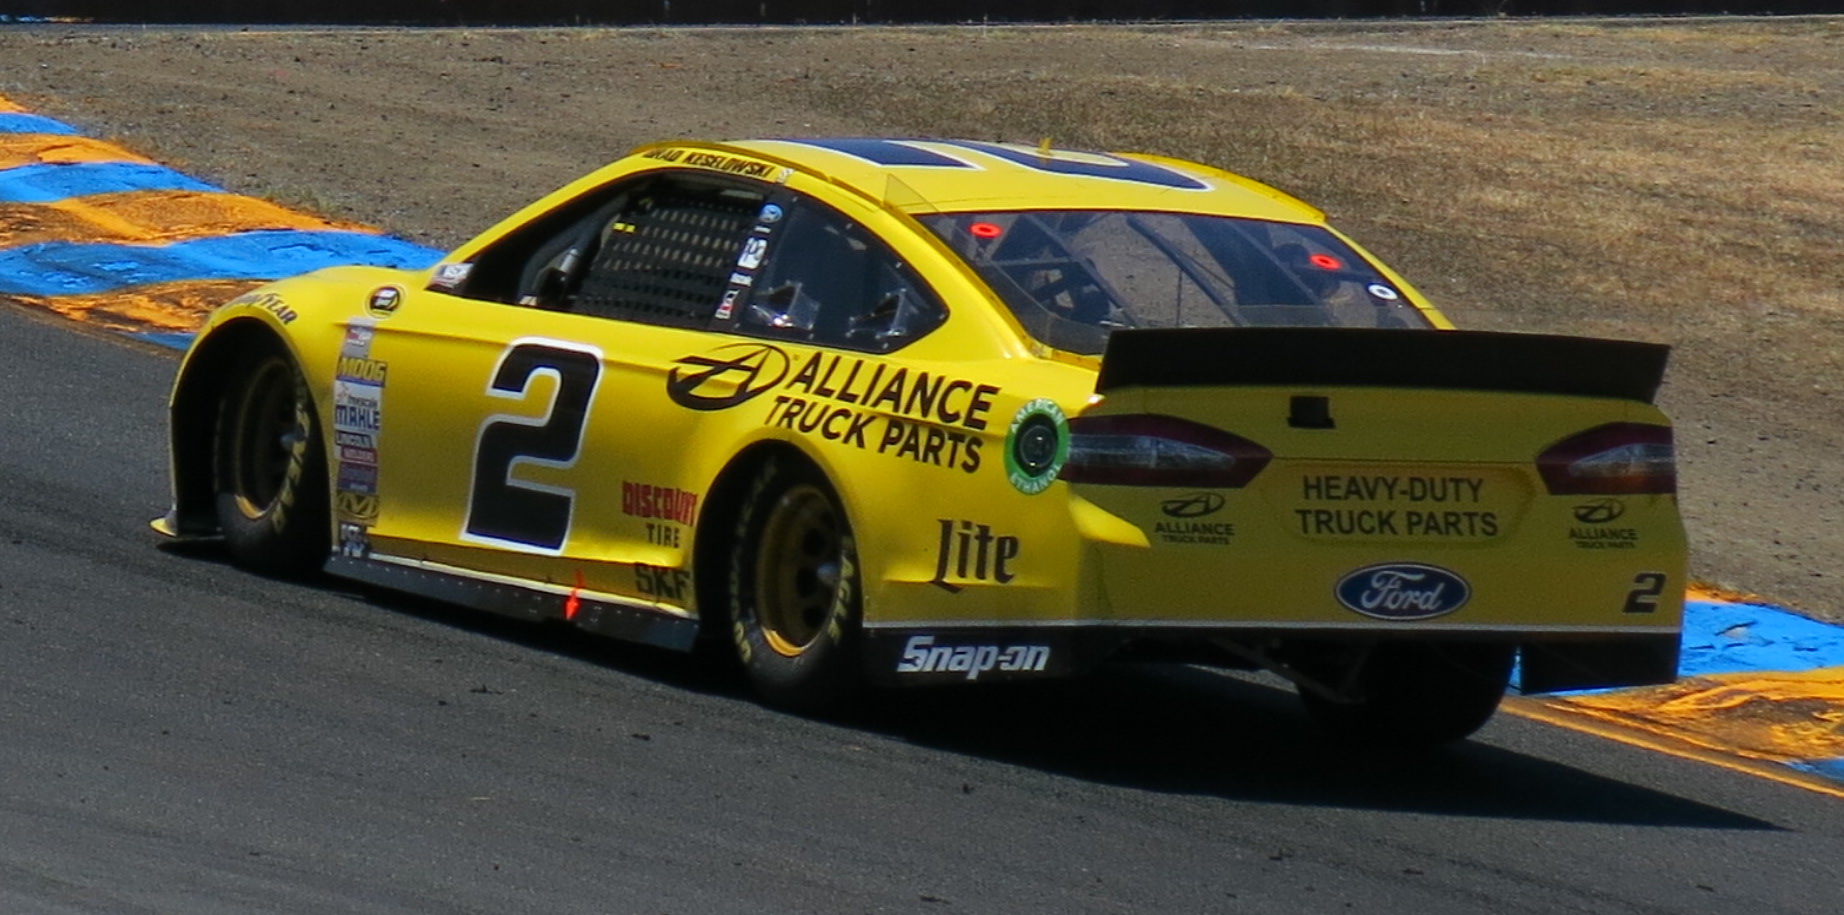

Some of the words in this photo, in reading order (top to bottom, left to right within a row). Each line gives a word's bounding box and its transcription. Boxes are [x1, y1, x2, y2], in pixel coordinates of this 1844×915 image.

[683, 153, 775, 176] KESELOWSKI
[339, 358, 386, 381] MOOG
[784, 352, 1002, 430] ALLIANCE
[336, 405, 380, 430] MAHLE
[1010, 398, 1065, 434] AMERICAN
[461, 337, 603, 555] 2
[764, 396, 878, 449] TRUCK
[877, 419, 984, 473] PARTS
[1010, 464, 1062, 495] ETHANOL
[1303, 475, 1484, 503] HEAVY-DUTY
[622, 481, 697, 527] DISCOUNT
[646, 522, 680, 549] TIRE
[1155, 522, 1235, 536] ALLIANCE
[1295, 509, 1399, 534] TRUCK
[1407, 511, 1499, 537] PARTS
[1568, 528, 1639, 541] ALLIANCE
[931, 518, 1019, 594] Lite
[1162, 536, 1197, 544] TRUCK
[1199, 536, 1231, 545] PARTS
[635, 564, 691, 600] SKF
[1359, 569, 1445, 611] Ford
[1622, 571, 1667, 614] 2
[897, 635, 1051, 681] Snap-on
